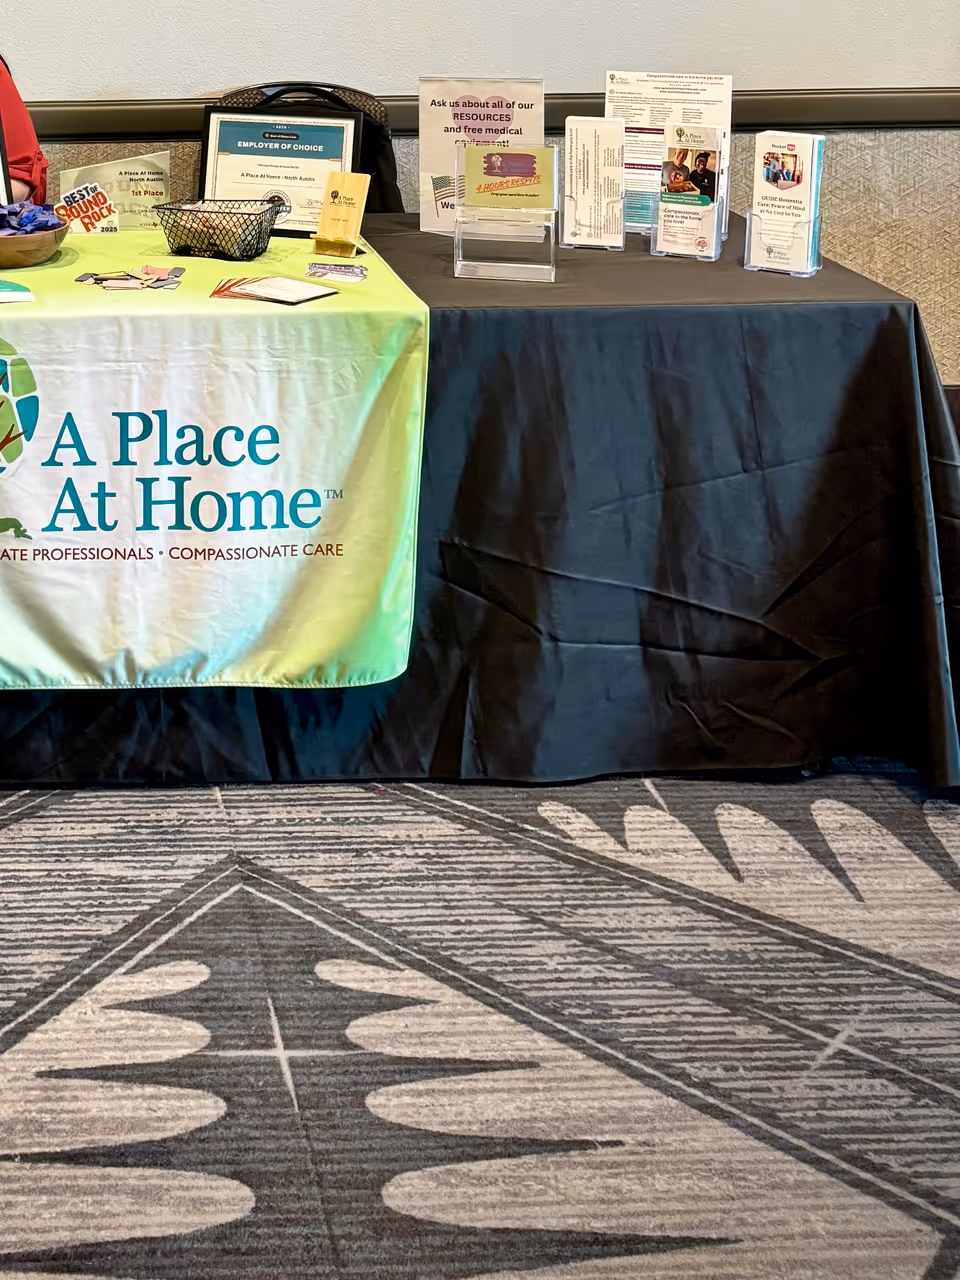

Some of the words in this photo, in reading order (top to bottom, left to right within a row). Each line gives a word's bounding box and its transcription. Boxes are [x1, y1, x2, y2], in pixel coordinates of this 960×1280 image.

[430, 99, 447, 107] Ask
[461, 100, 490, 109] about
[491, 100, 504, 109] all
[505, 100, 516, 109] of
[453, 112, 511, 122] RESOURCES
[443, 125, 462, 134] and
[463, 126, 483, 134] free
[485, 127, 523, 135] medical
[237, 141, 279, 149] EMPLOYER
[293, 144, 324, 152] CHOICE
[476, 184, 482, 192] 4
[482, 179, 510, 192] HOURS
[510, 174, 542, 188] RESPITE
[62, 186, 91, 208] BEST
[90, 185, 99, 196] OF
[778, 197, 803, 205] Dementia
[54, 191, 109, 223] ROUND
[440, 201, 455, 210] We
[663, 208, 700, 216] Compassionate
[80, 204, 117, 233] ROCK
[41, 411, 98, 467] A
[111, 409, 281, 467] Place
[41, 477, 119, 533] At
[134, 476, 323, 533] Home
[32, 546, 155, 563] PROFESSIONALS
[168, 545, 300, 561] COMPASSIONATE
[302, 543, 345, 559] CARE
